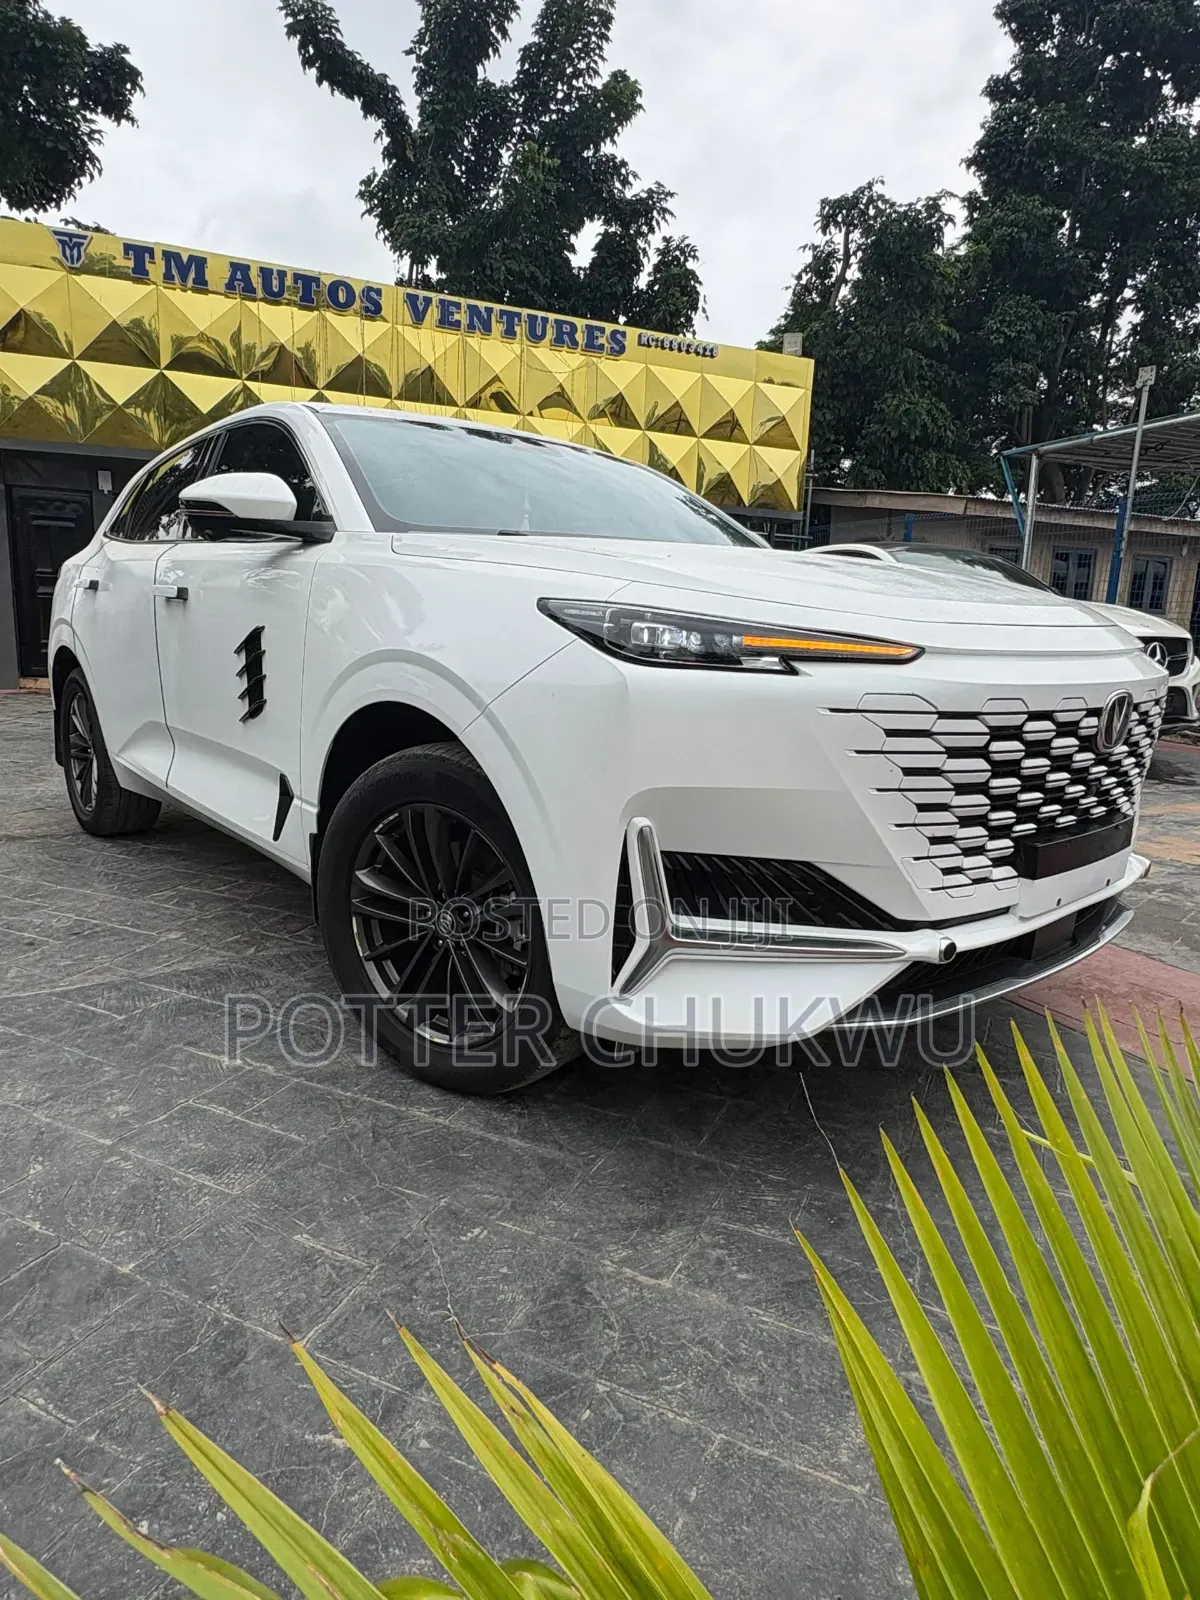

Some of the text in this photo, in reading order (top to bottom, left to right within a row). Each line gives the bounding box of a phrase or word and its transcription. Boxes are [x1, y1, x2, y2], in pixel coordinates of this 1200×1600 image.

[122, 242, 628, 357] TM AUTOS VENTURES
